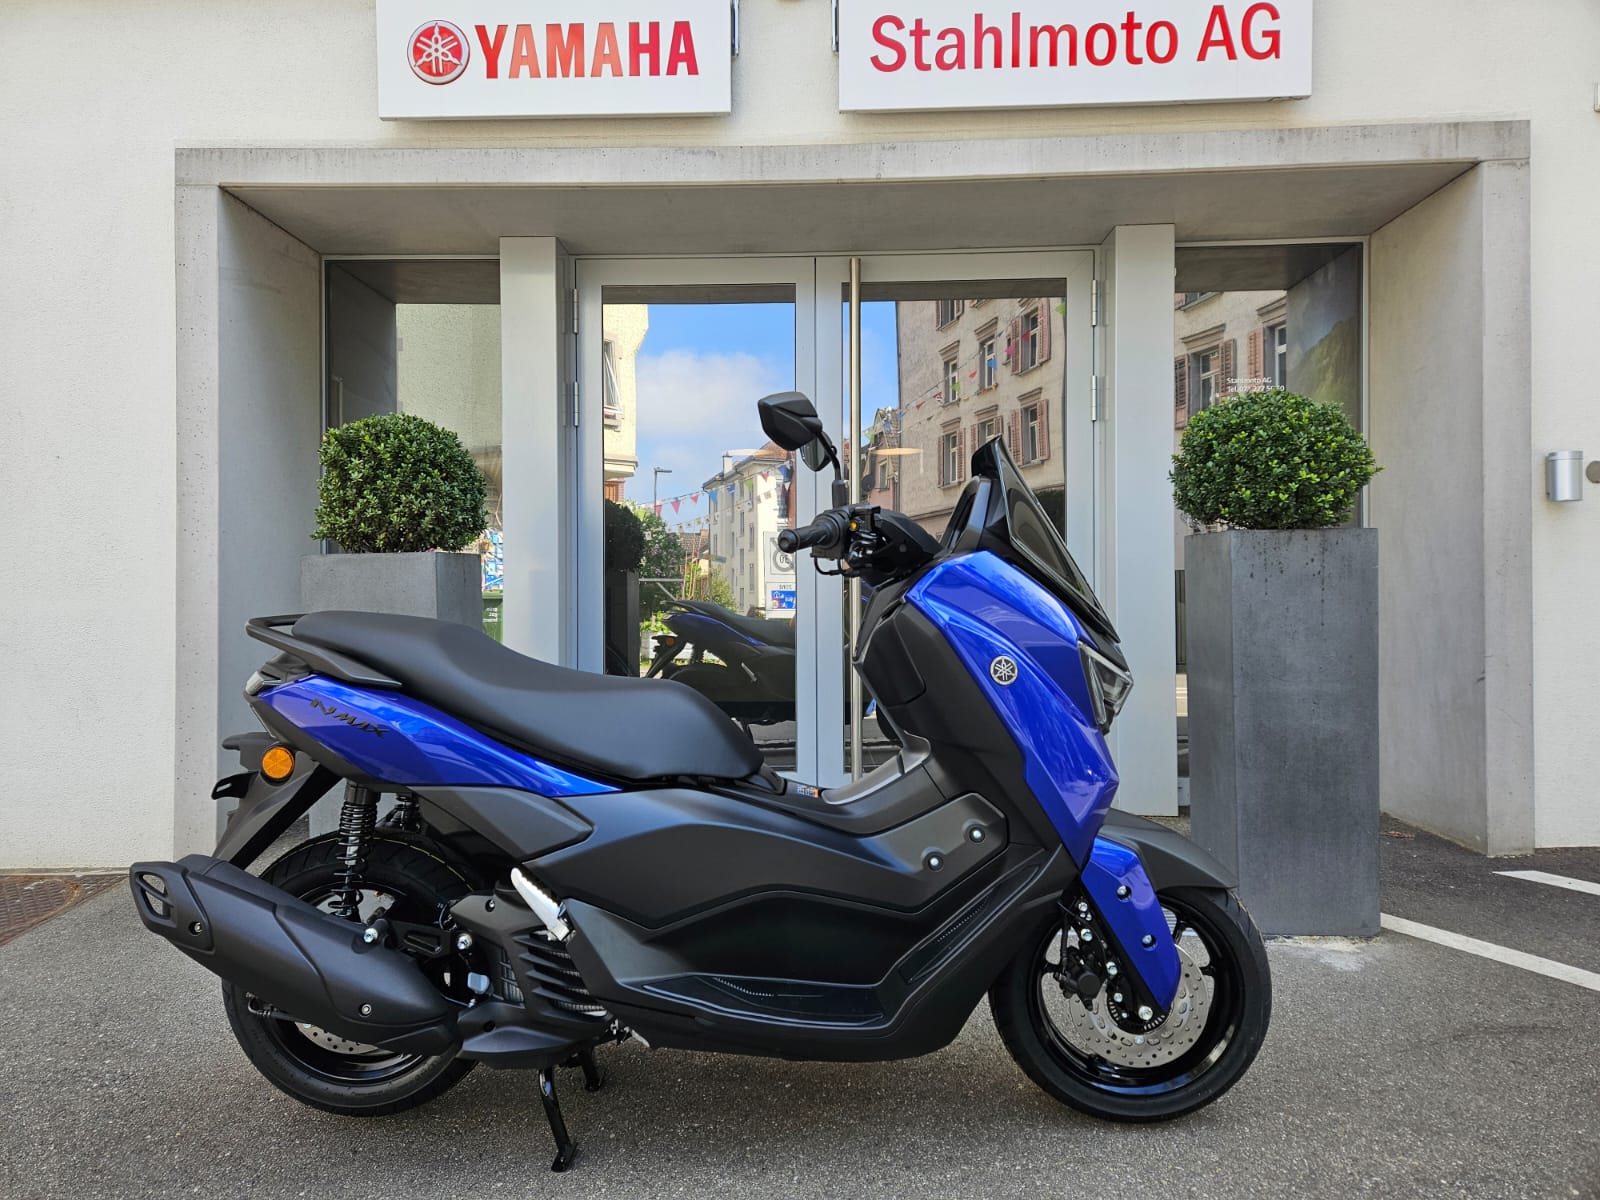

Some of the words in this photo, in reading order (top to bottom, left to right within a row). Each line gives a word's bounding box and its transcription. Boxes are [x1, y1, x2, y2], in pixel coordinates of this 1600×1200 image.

[475, 21, 698, 79] YAMAHA
[870, 13, 1179, 73] Stahlmoto
[1197, 3, 1281, 62] AG
[310, 698, 390, 738] NMAX
